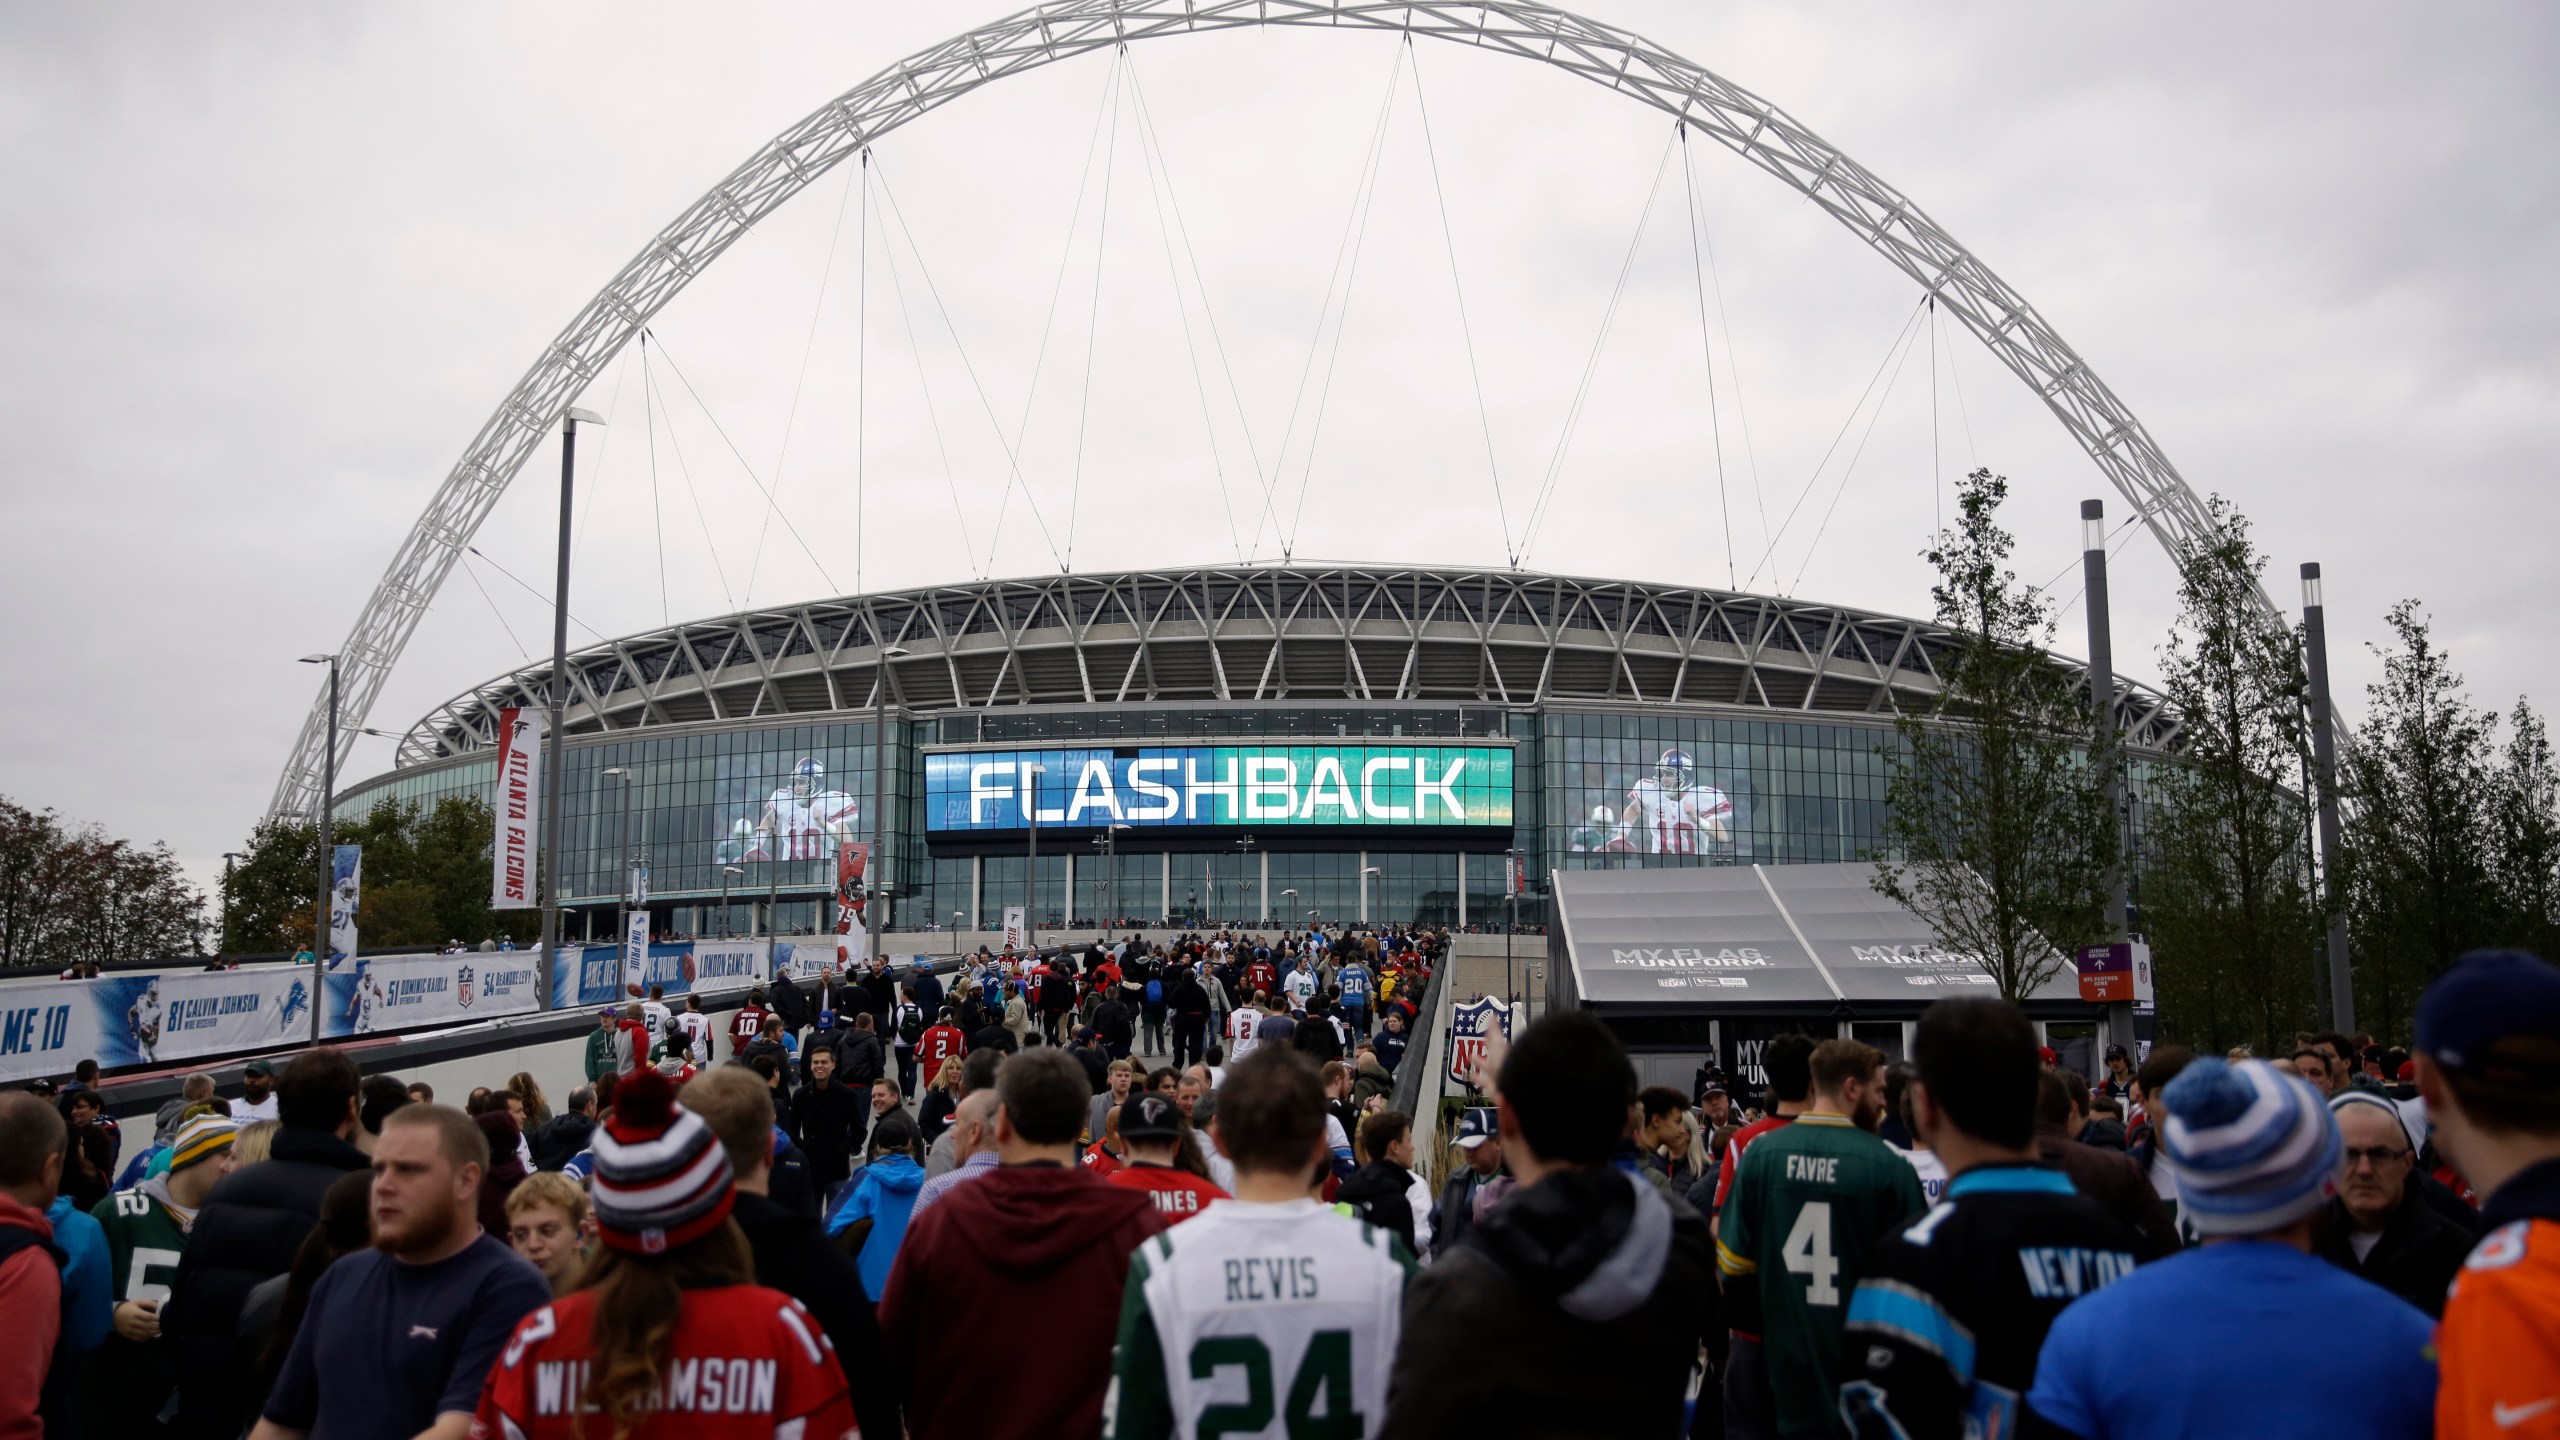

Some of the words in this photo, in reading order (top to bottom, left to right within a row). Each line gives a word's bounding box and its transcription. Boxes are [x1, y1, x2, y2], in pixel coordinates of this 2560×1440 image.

[508, 748, 529, 820] ATLANTA
[970, 757, 1469, 824] FLASHBACK
[946, 800, 1001, 820] GIATS
[505, 826, 526, 901] FALCONS
[631, 930, 641, 945] ONE
[630, 947, 640, 971] PRIDE
[1612, 949, 1663, 960] MY
[1672, 948, 1771, 960] FLAG.
[1638, 958, 1775, 967] UNIFORM.
[1850, 945, 1902, 957] MY
[519, 970, 532, 984] LEVY
[585, 961, 603, 989] ONE
[658, 956, 679, 982] PRIDE
[699, 954, 727, 978] LONDON
[727, 953, 745, 976] GAME
[745, 953, 754, 975] 10
[1001, 961, 1012, 971] 88
[1256, 970, 1263, 982] 11
[387, 980, 399, 1006] 51
[461, 983, 473, 1004] NFL
[483, 972, 495, 997] 54
[1299, 983, 1312, 997] 25
[1344, 979, 1362, 994] 20
[167, 1000, 185, 1032] 81
[186, 998, 219, 1018] CALVIN
[219, 993, 260, 1015] JOHNSON
[0, 1007, 40, 1056] ME
[40, 1004, 72, 1051] 10
[738, 1018, 758, 1036] 10
[1240, 1021, 1251, 1039] 2
[935, 1039, 947, 1059] 2
[1736, 1040, 1764, 1065] MY
[1737, 1064, 1748, 1076] MY
[1787, 1155, 1840, 1183] FAVRE
[1902, 1200, 1958, 1248] 1
[1782, 1202, 1840, 1307] 4
[1225, 1257, 1318, 1301] REVIS
[1189, 1328, 1365, 1440] 24
